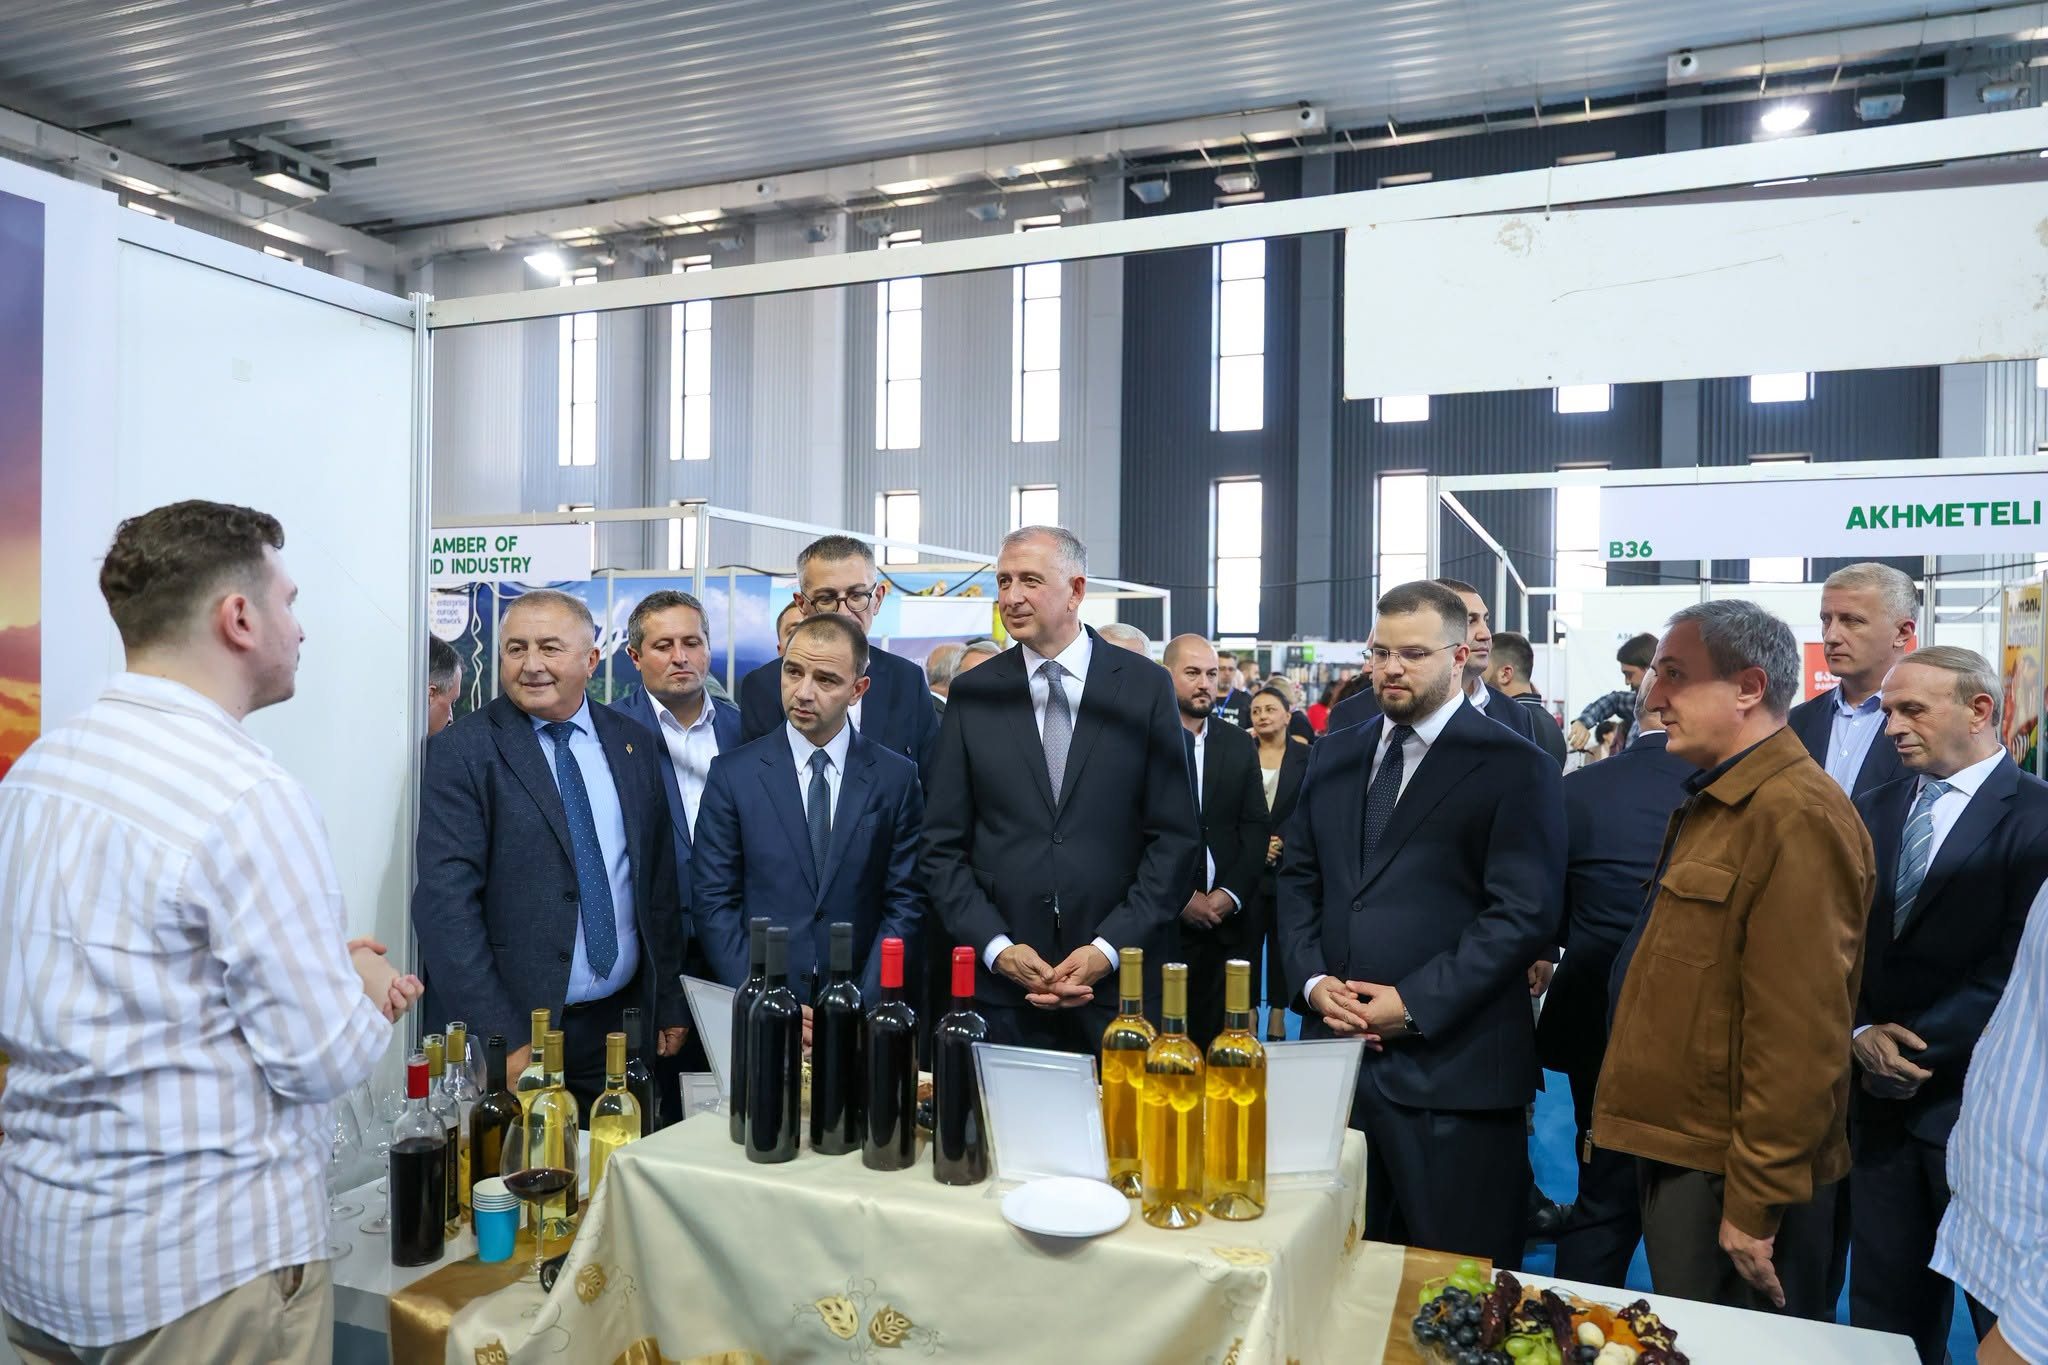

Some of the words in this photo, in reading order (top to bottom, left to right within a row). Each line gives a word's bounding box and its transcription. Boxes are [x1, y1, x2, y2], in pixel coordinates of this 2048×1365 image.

[1846, 500, 2041, 530] AKHMETELI
[432, 536, 487, 553] AMBER
[495, 536, 518, 552] OF
[1609, 540, 1653, 558] B36
[451, 557, 532, 574] INDUSTRY
